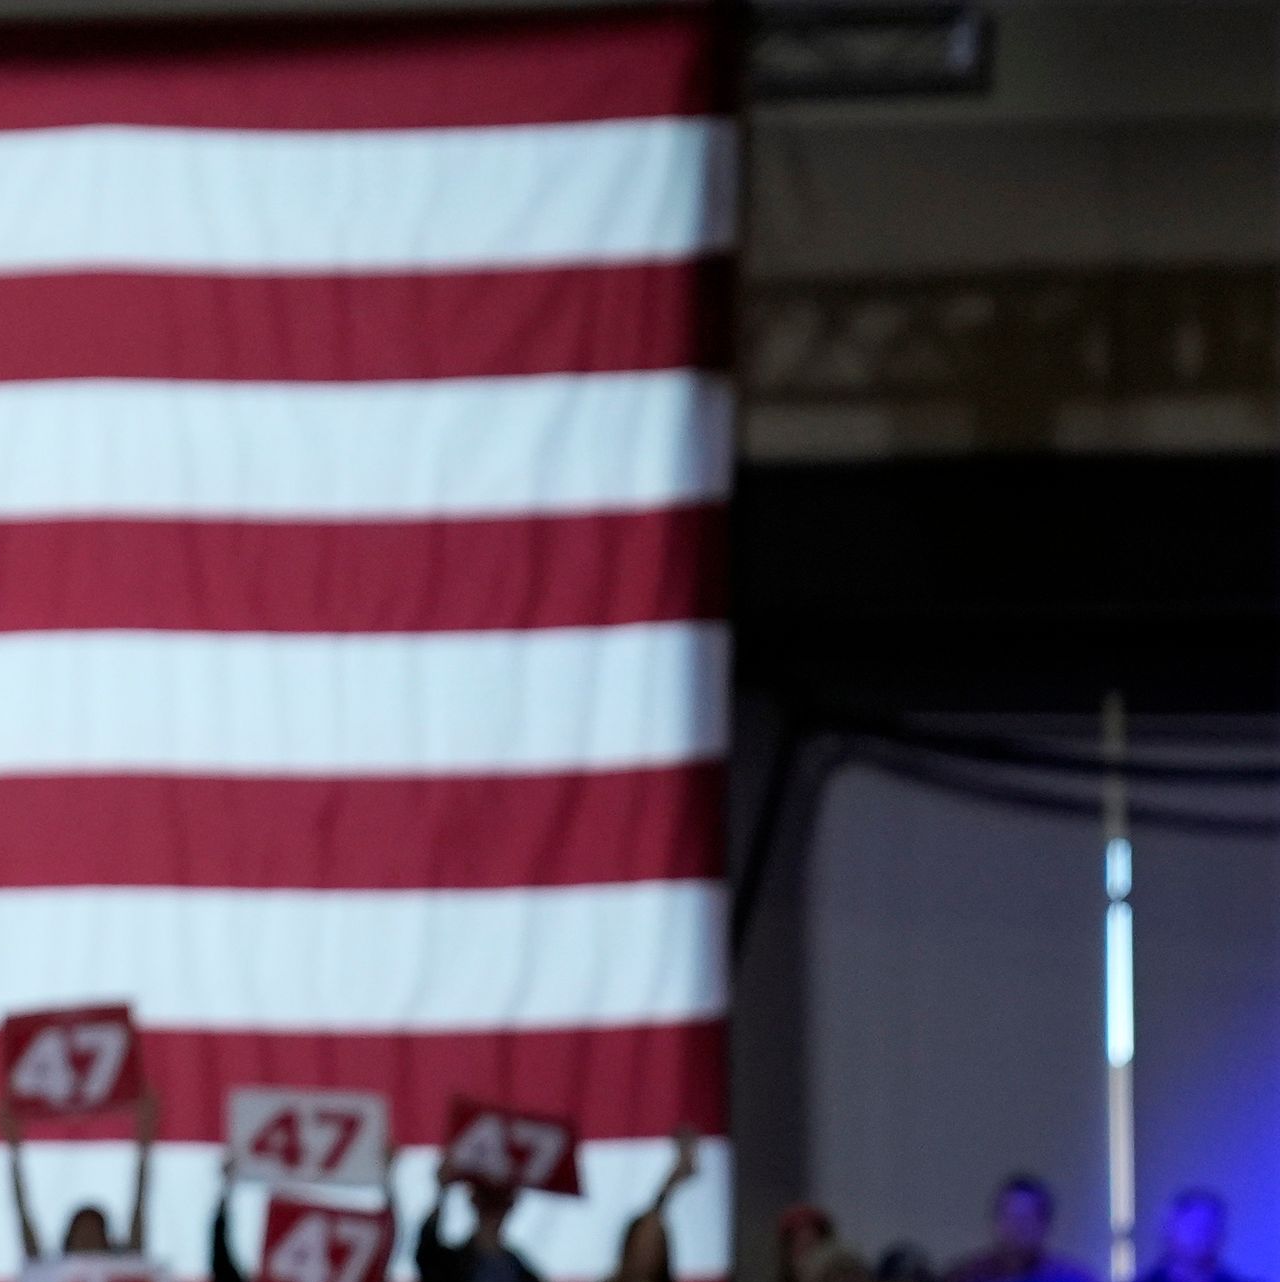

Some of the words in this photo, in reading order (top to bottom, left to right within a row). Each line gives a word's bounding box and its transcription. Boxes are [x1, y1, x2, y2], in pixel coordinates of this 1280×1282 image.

[11, 1022, 129, 1109] 47
[251, 1110, 363, 1173] 47
[451, 1113, 569, 1181] 47
